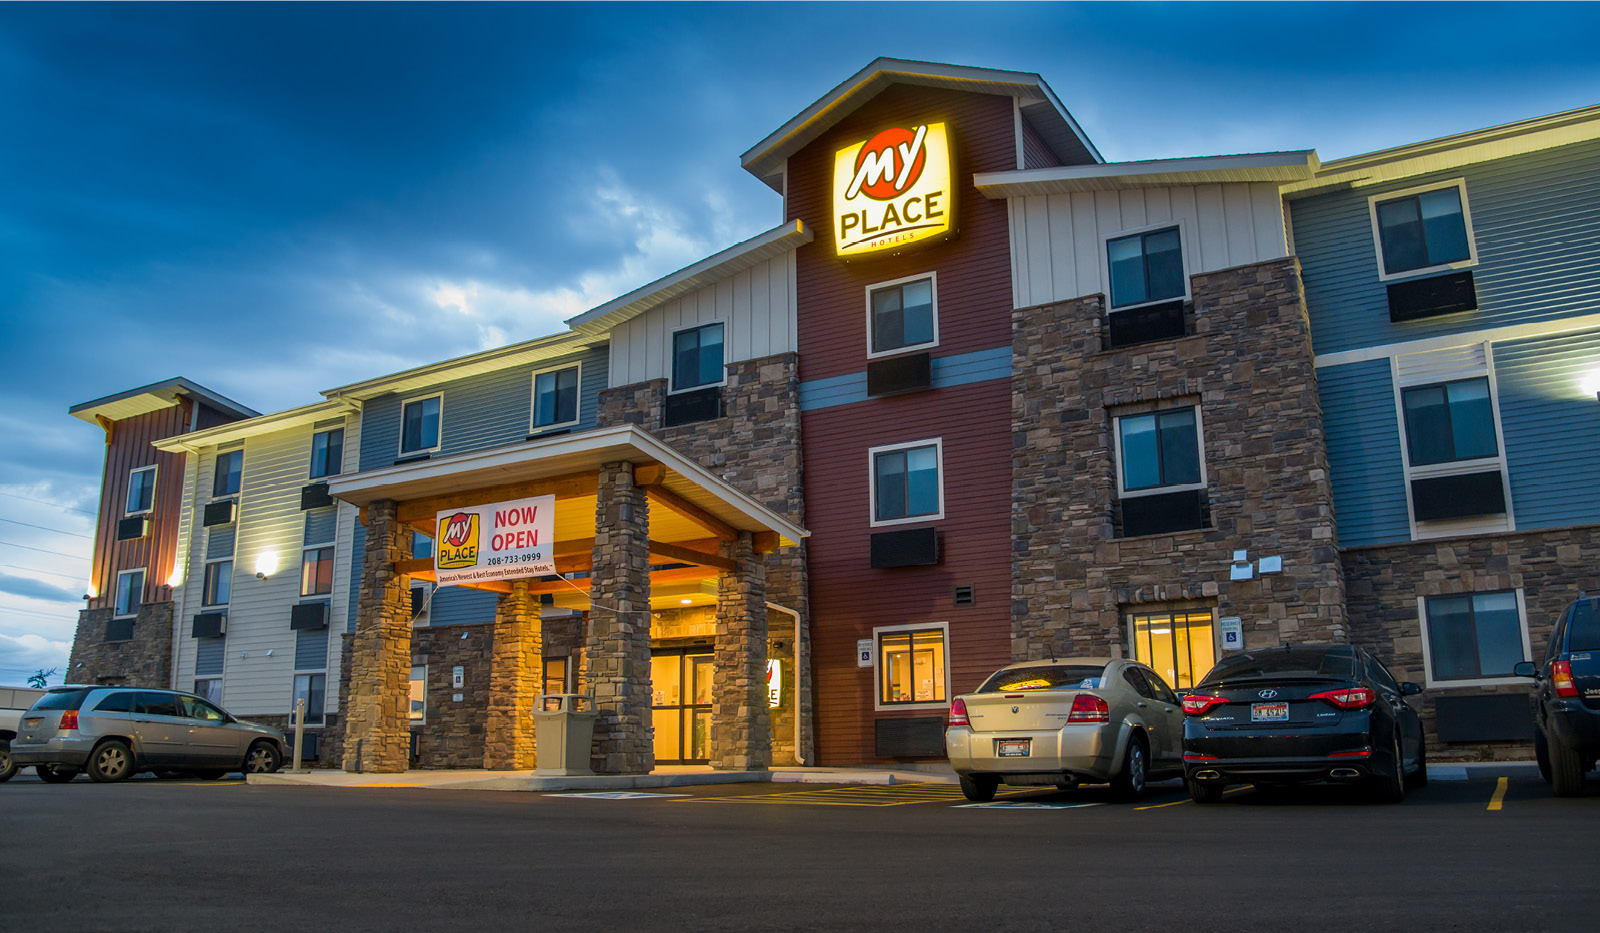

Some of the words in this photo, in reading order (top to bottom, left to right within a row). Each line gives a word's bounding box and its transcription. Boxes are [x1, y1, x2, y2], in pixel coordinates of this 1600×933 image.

[841, 191, 944, 240] PLACE
[871, 233, 915, 248] HOTELS
[494, 505, 538, 529] NOW
[491, 529, 539, 552] OPEN
[440, 546, 476, 562] PLACE
[487, 552, 541, 566] 208-733-0999
[504, 567, 524, 576] Extended
[524, 566, 534, 574] Stay
